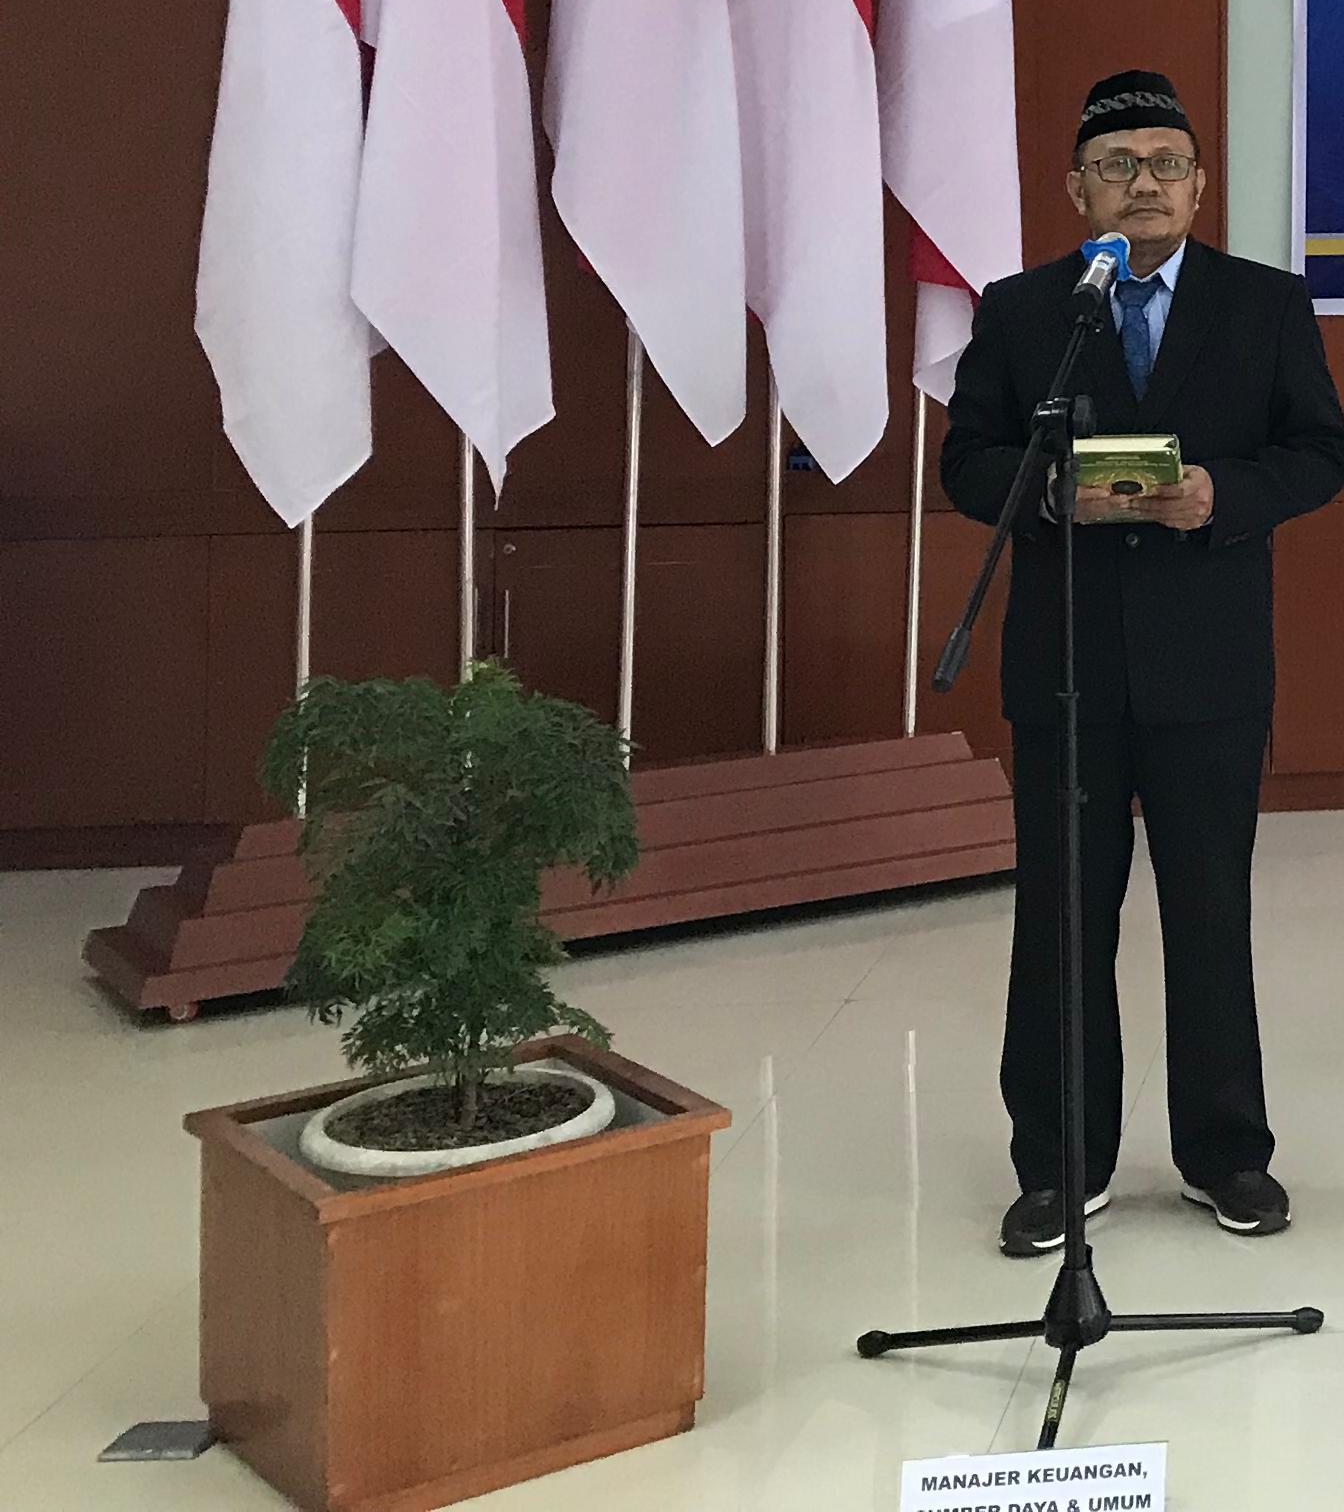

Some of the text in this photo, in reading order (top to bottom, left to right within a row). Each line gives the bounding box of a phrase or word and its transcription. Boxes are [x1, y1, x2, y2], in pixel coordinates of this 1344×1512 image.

[921, 1462, 1148, 1492] MANAJER KEUANGAN,
[1088, 1493, 1151, 1512] UMUM
